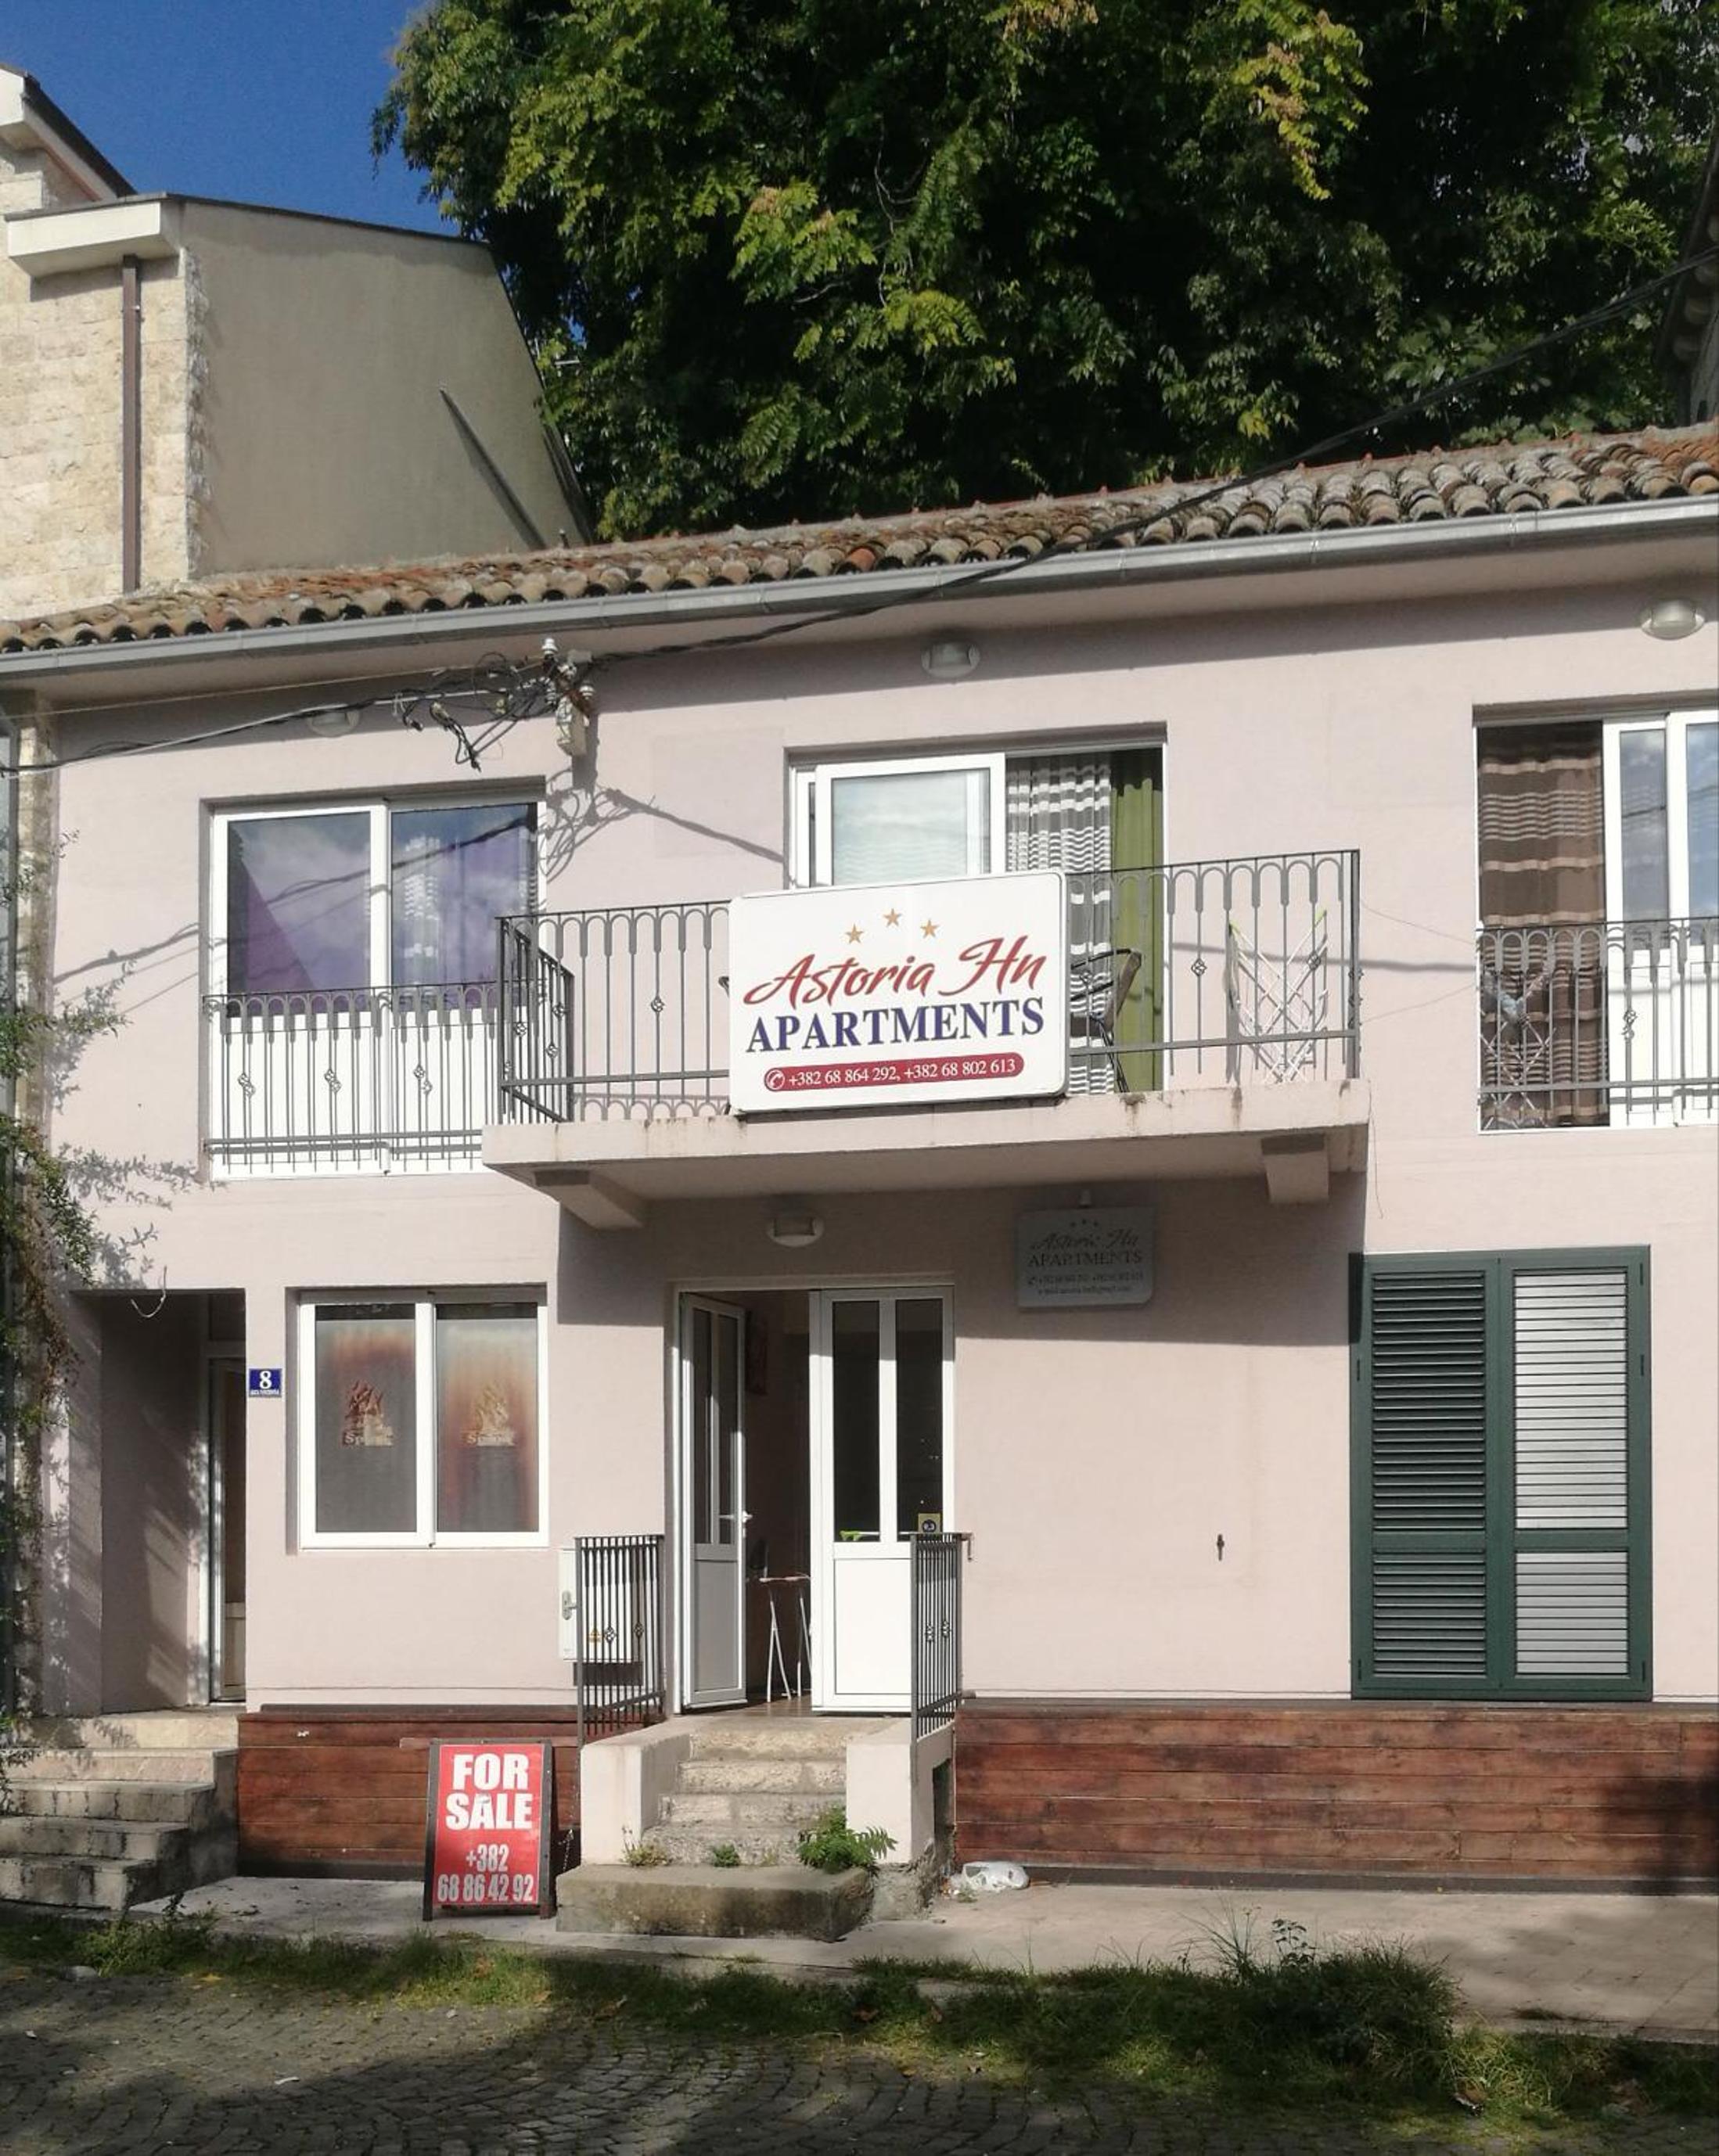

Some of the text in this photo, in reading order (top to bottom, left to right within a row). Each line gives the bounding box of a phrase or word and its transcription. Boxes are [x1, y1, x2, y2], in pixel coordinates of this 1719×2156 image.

[743, 954, 935, 1009] Astoria
[746, 997, 1045, 1053] APARTMENTS
[789, 1058, 1016, 1086] +382 68 864 292, +382 68 802 613
[1027, 1251, 1142, 1267] APARTMENTS
[260, 1371, 272, 1389] 8
[452, 1753, 530, 1790] FOR
[445, 1793, 533, 1830] SALE
[466, 1844, 509, 1872] +382
[437, 1874, 534, 1902] 68 86 42 92
